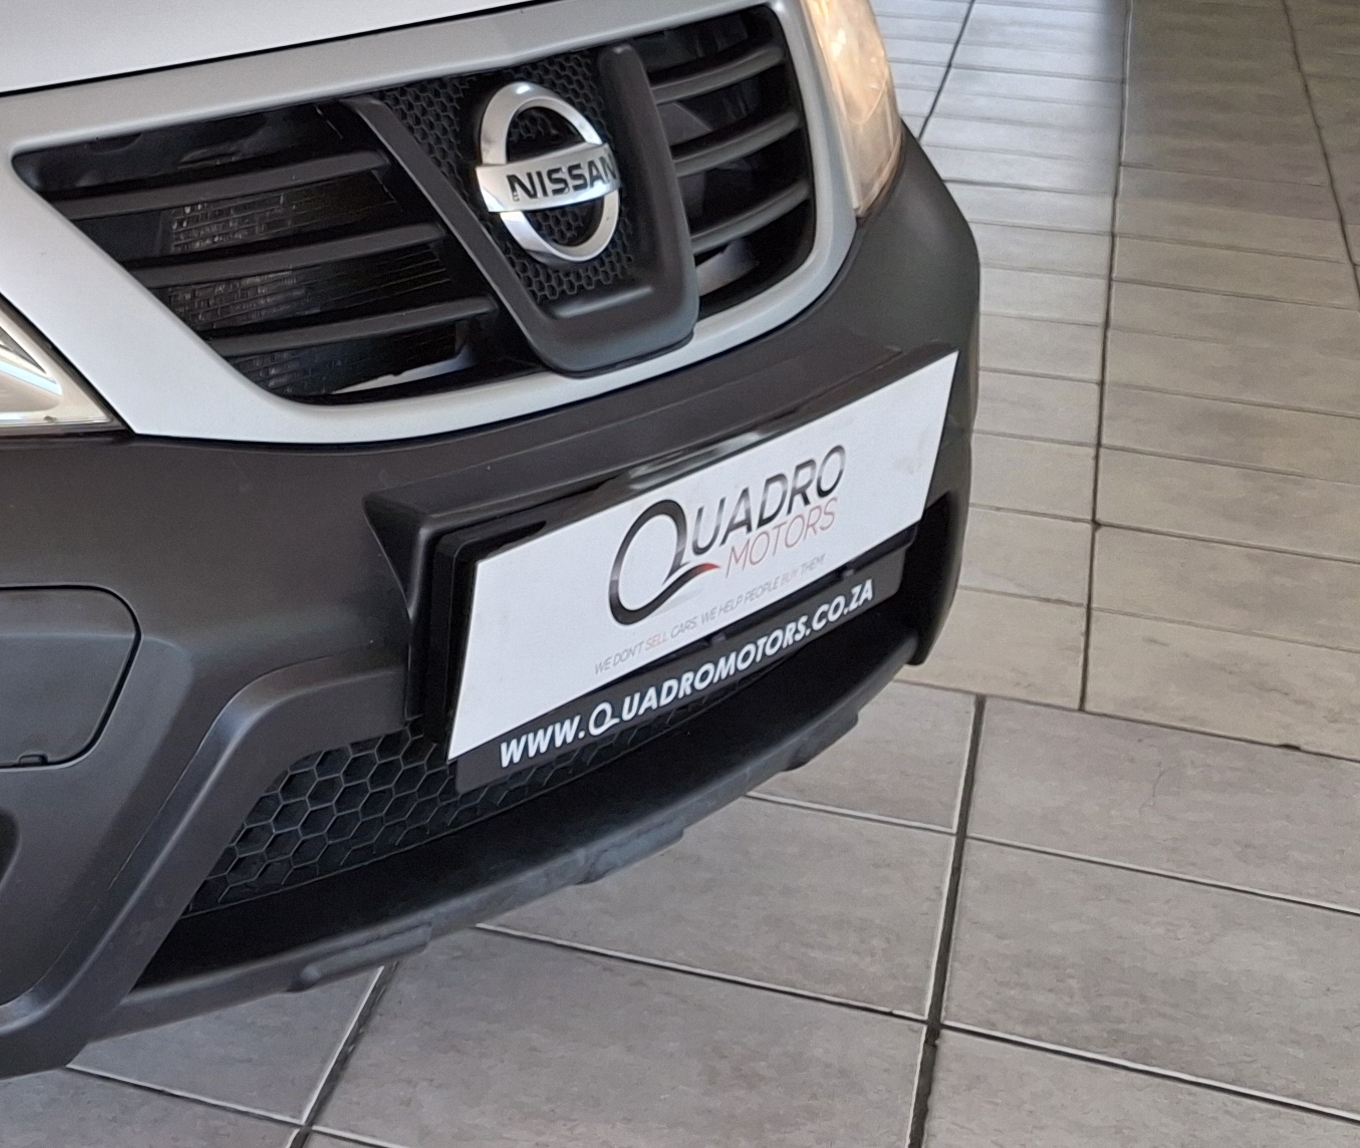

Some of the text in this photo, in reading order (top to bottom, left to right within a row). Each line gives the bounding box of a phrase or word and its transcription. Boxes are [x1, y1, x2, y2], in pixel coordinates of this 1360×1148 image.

[505, 154, 618, 202] NISSAN
[608, 444, 847, 626] QUADRO
[725, 496, 839, 579] MOTORS
[499, 578, 875, 769] WWW.QUADROMOTORS.CO.ZA
[595, 658, 613, 675] WE
[644, 633, 669, 652] SELL
[700, 608, 717, 626] WE
[715, 595, 745, 619] HELP
[742, 577, 782, 605] PEOPLE
